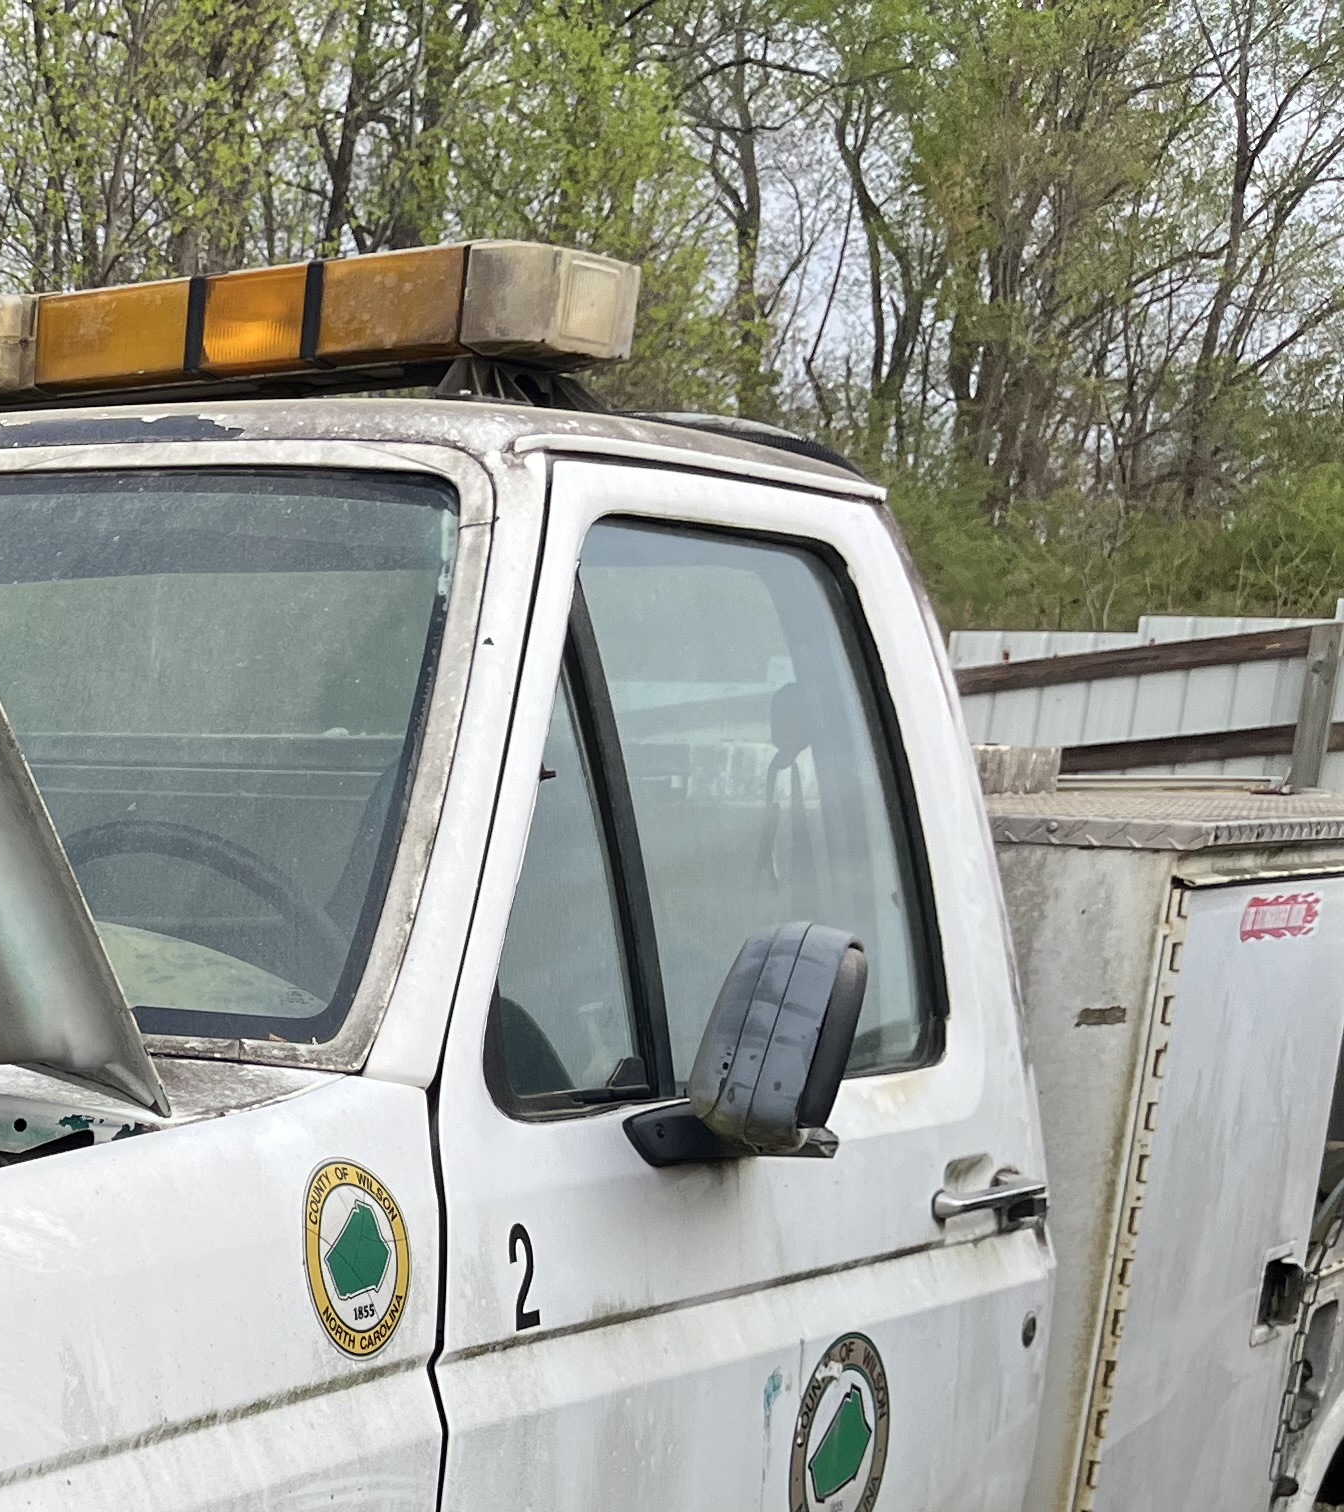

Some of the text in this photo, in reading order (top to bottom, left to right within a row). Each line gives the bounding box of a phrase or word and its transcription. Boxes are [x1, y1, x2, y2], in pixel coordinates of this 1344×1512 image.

[309, 1167, 397, 1226] COUNTY OF WILSON
[508, 1223, 541, 1331] 2
[323, 1294, 403, 1351] NORTH CAROLINA
[353, 1303, 375, 1321] 1855
[839, 1341, 855, 1362] OF
[862, 1346, 886, 1422] WILSON
